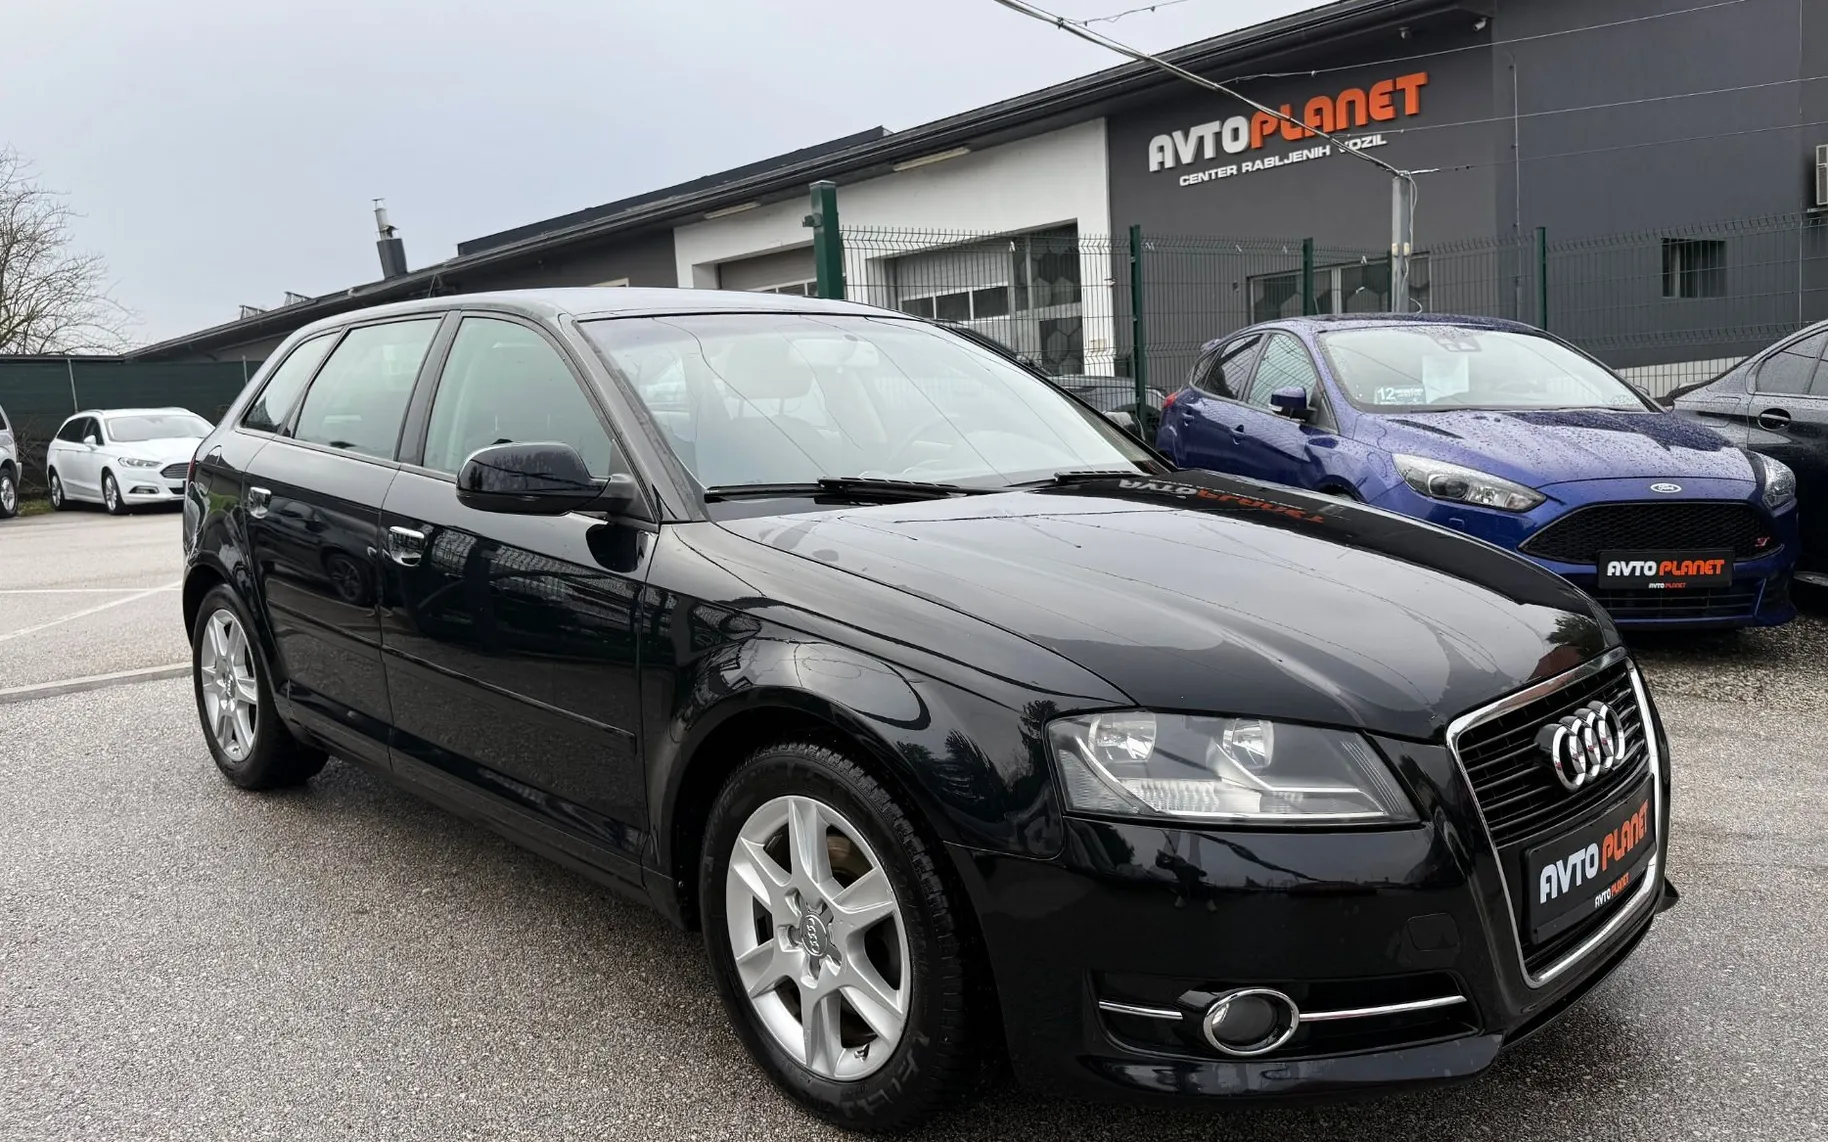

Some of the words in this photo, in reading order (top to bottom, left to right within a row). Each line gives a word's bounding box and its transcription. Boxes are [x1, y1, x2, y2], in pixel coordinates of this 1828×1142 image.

[1179, 164, 1238, 187] CENTER
[1241, 144, 1332, 174] RABLJENIH
[1377, 386, 1396, 401] 12
[1606, 560, 1657, 577] AVTO
[1658, 559, 1725, 576] PLANET
[1539, 842, 1599, 904] AVTO
[1601, 799, 1649, 872] PLANET
